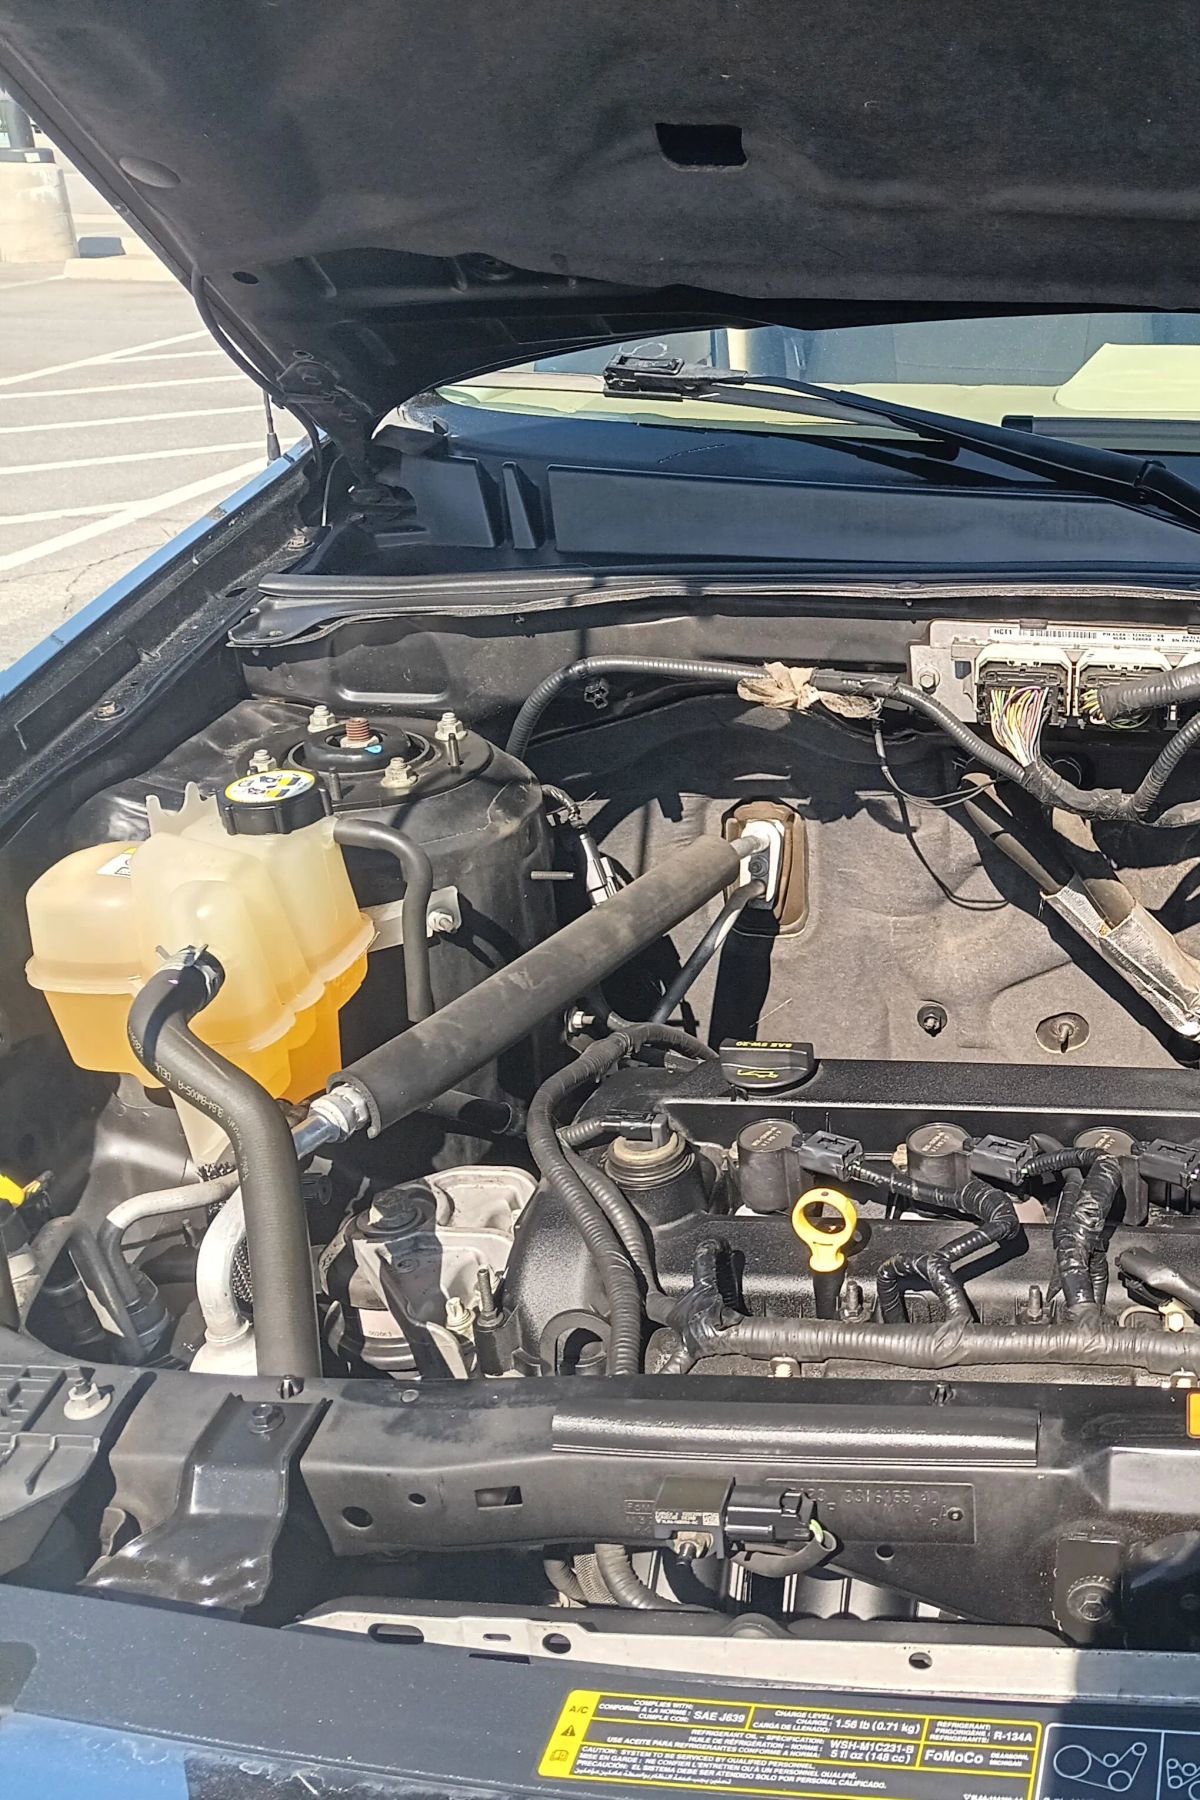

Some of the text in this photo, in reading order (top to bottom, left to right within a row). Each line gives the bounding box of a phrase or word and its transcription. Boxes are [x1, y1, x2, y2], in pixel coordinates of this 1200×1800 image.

[599, 1704, 640, 1712] CONFORME
[775, 1710, 807, 1718] CHARGE
[693, 1710, 746, 1723] SAE J639
[792, 1725, 830, 1733] LLENADO:
[836, 1719, 920, 1734] 1.56 lb (0.71 kg)
[936, 1721, 991, 1730] REFRIGERANT:
[691, 1729, 744, 1739] REFRIGERANT
[766, 1735, 825, 1744] SPECIFICATION:
[994, 1730, 1032, 1742] R-134A
[674, 1742, 737, 1752] REFRIGERANTES
[738, 1747, 782, 1755] CONFORME
[830, 1739, 914, 1754] WSH-M1C231-B
[727, 1758, 767, 1766] QUALIFIED
[830, 1750, 837, 1758] 5
[840, 1750, 848, 1758] fl
[865, 1751, 890, 1762] (148
[891, 1754, 911, 1764] cc)
[924, 1749, 984, 1764] FoMoCo
[577, 1760, 629, 1769] PRECAUCIÓN:
[715, 1770, 754, 1779] ATENDIDO
[796, 1777, 838, 1785] PERSONAL
[838, 1779, 886, 1789] CALIFICADO.
[657, 1759, 691, 1767] CONFIER
[692, 1761, 740, 1771] L'ENTRETIEN
[774, 1769, 819, 1777] PERSONNEL
